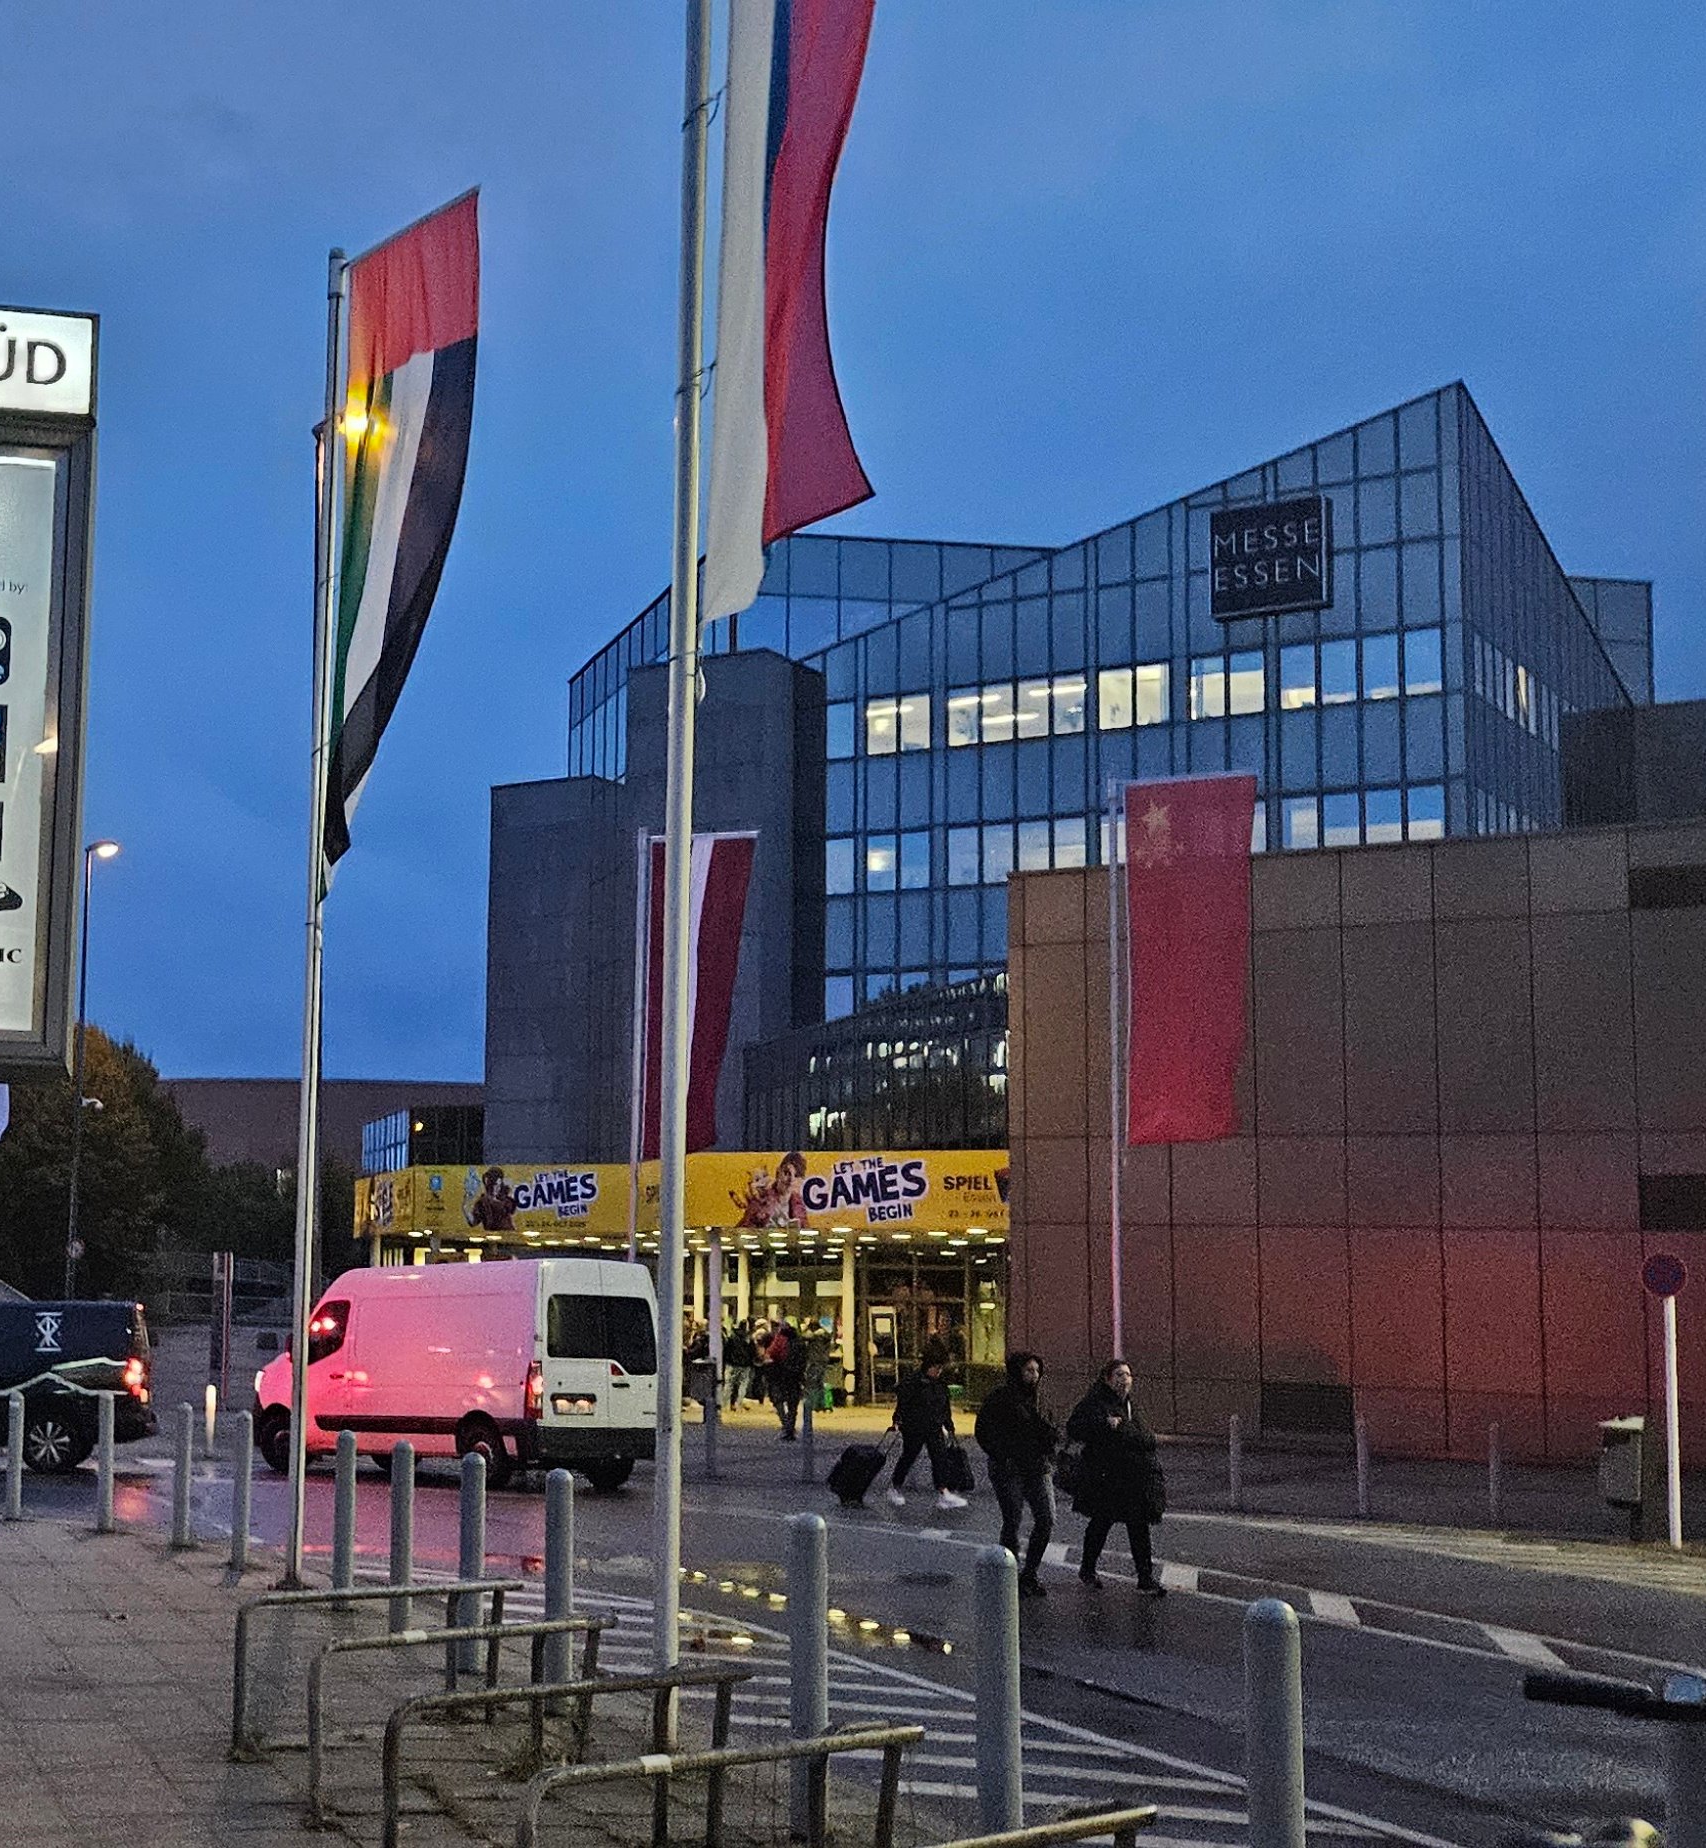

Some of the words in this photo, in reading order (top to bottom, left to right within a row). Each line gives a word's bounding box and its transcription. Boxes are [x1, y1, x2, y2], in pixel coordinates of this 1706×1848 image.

[1213, 517, 1319, 558] MESSE
[1214, 554, 1321, 592] ESSEN
[833, 1161, 855, 1175] LET
[859, 1156, 884, 1171] THE
[513, 1173, 597, 1210] GAMES
[802, 1161, 927, 1211] GAMES
[943, 1175, 992, 1191] SPIEL
[557, 1203, 589, 1218] BEGIN
[868, 1203, 914, 1222] BEGIN
